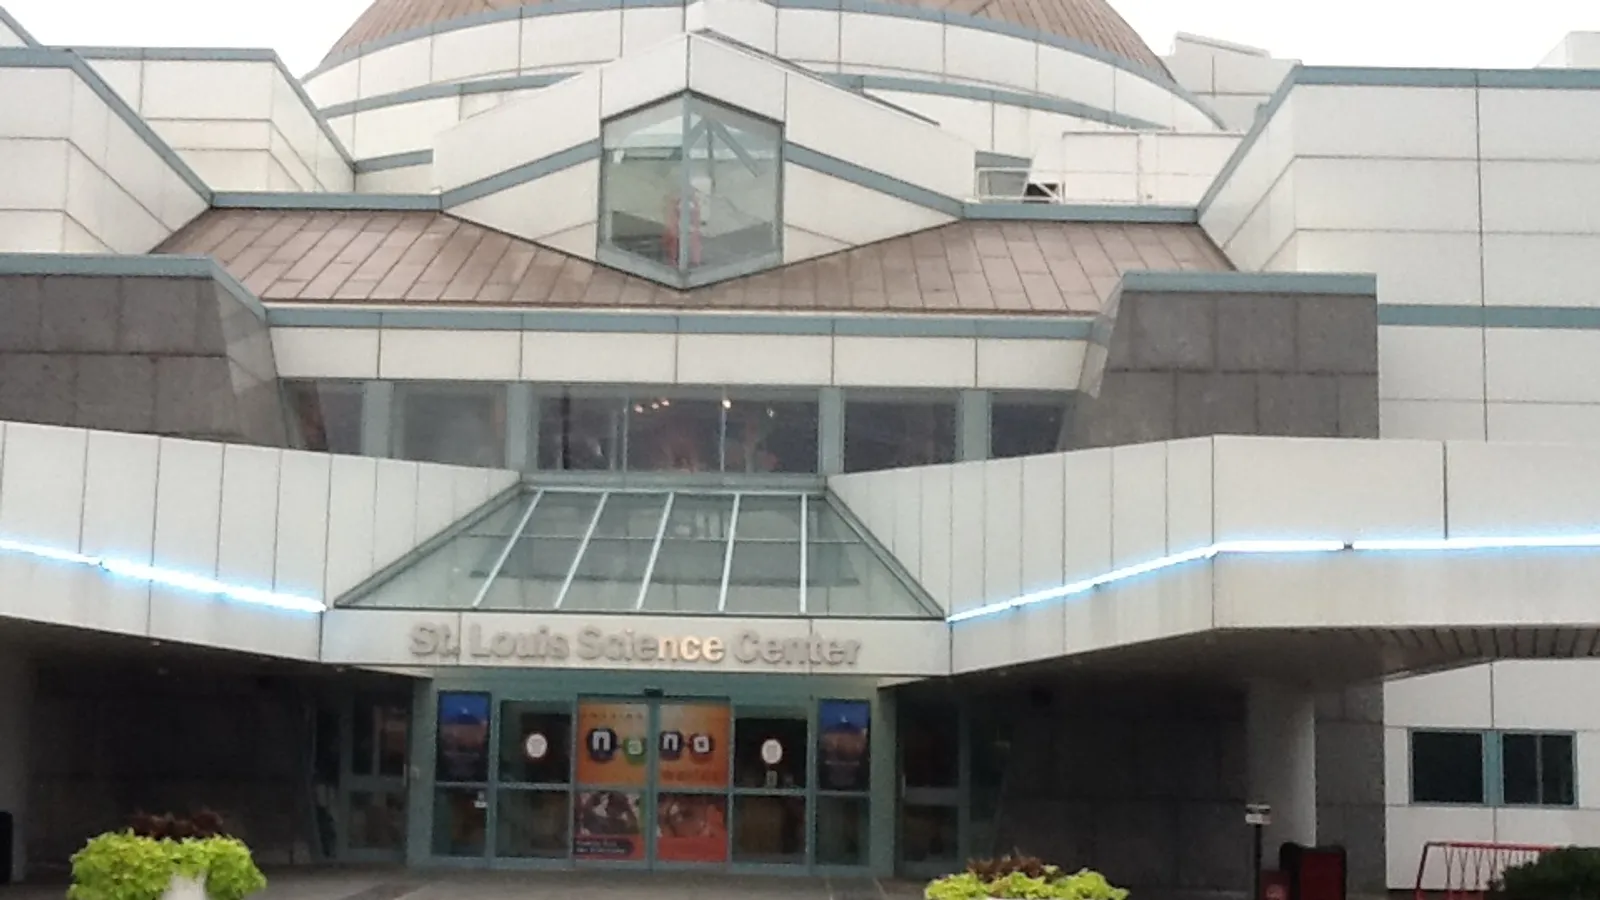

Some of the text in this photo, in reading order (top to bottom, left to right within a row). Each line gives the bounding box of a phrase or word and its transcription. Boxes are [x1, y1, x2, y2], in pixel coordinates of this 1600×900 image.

[410, 622, 862, 665] St. Louis Science Center
